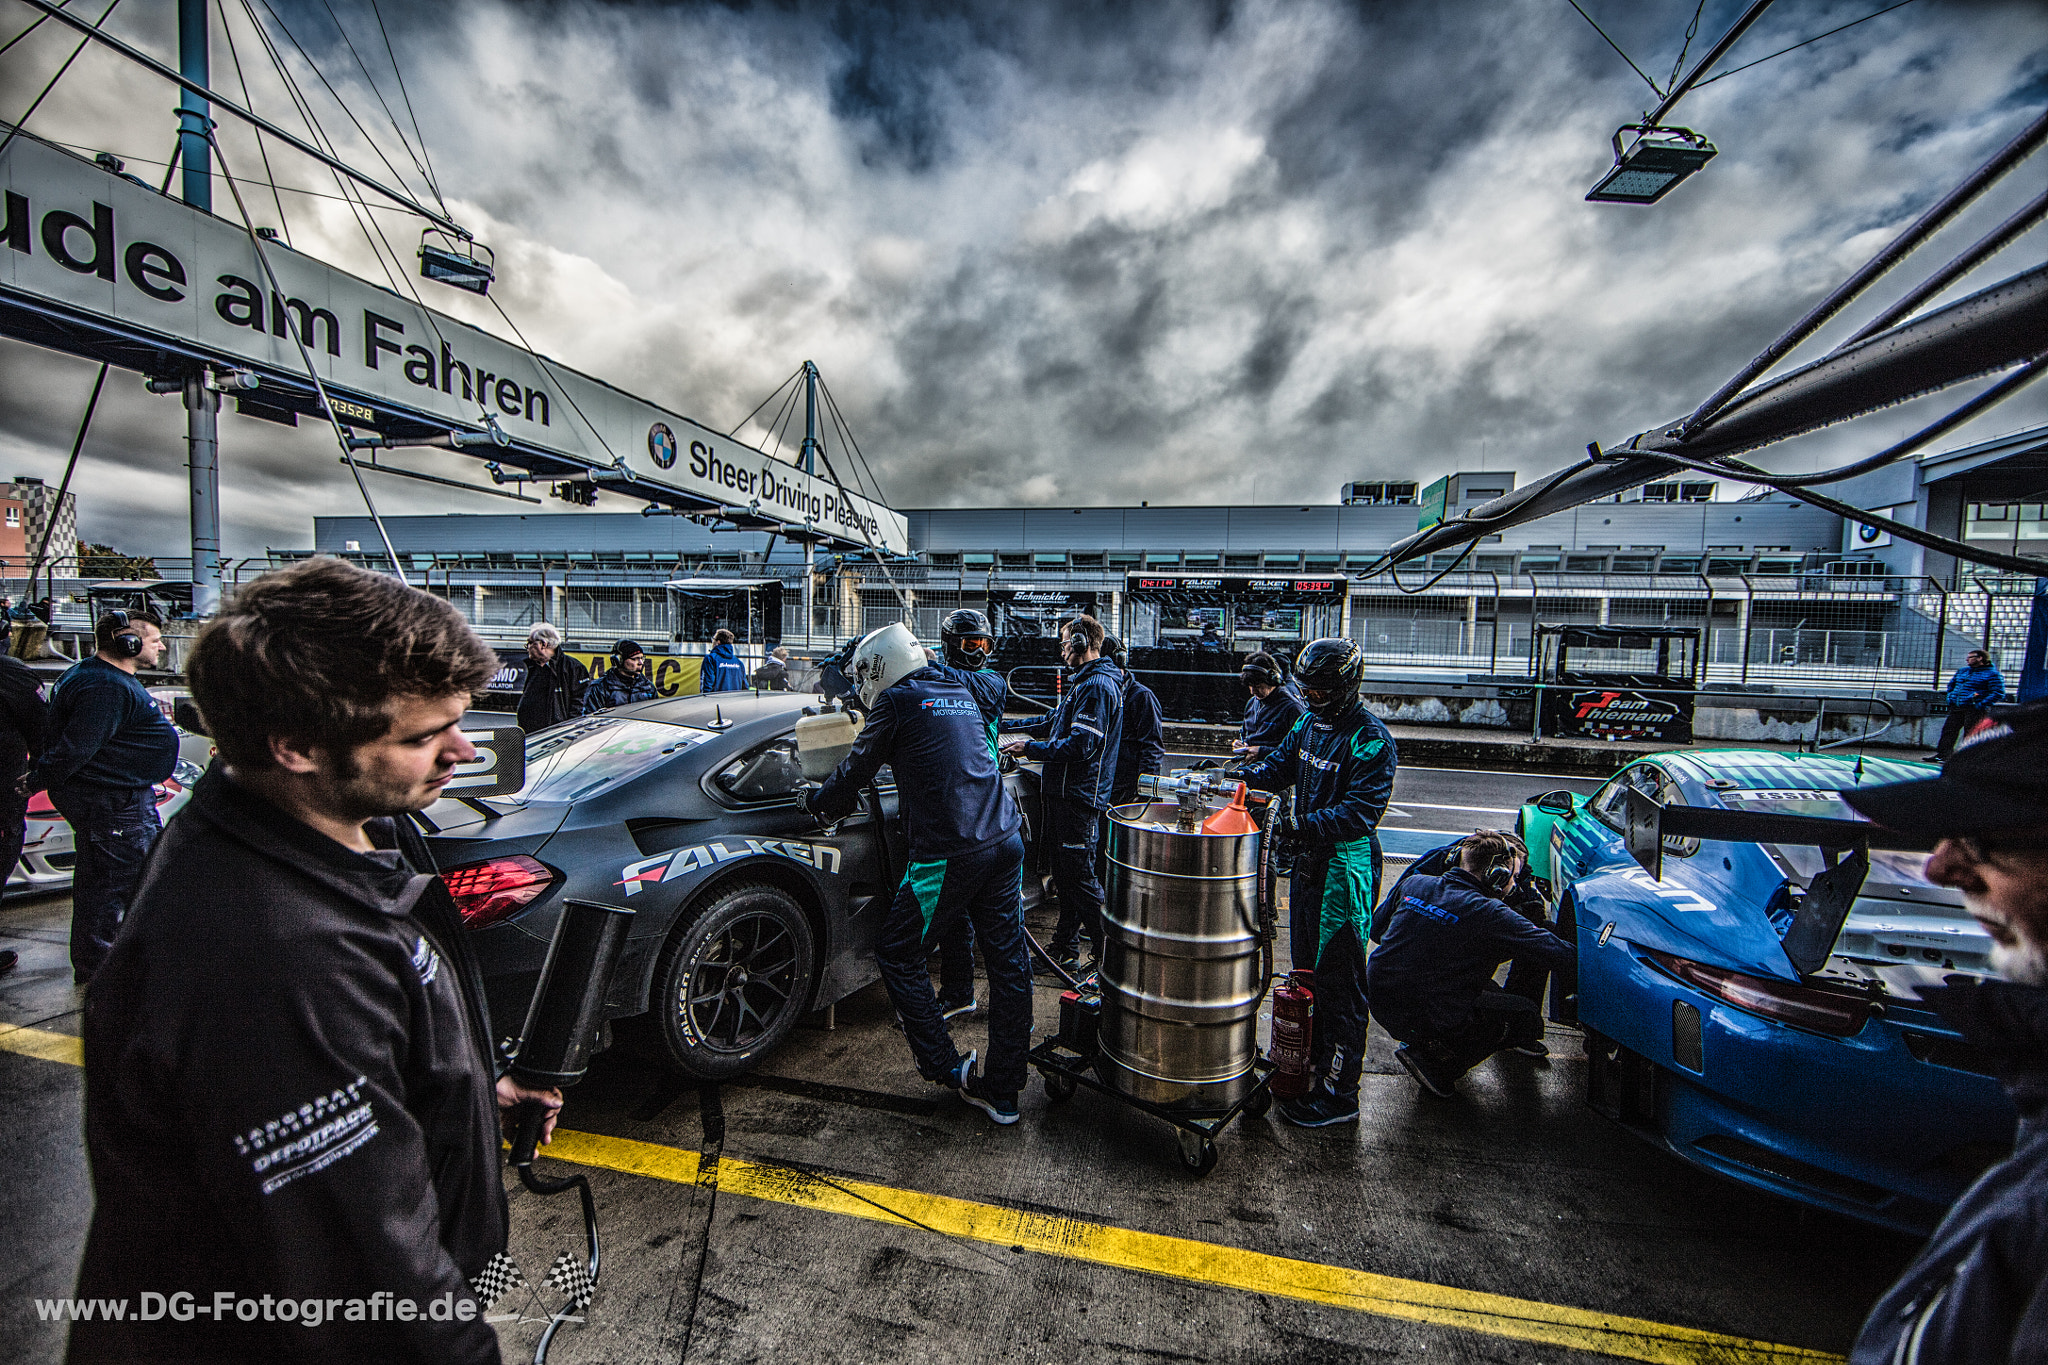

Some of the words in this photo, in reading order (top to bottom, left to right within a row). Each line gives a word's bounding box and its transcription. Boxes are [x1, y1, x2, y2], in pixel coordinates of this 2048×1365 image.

[216, 274, 340, 357] am
[364, 309, 550, 426] Fahren
[689, 440, 758, 495] Sheer
[762, 468, 820, 523] Driving
[825, 492, 878, 535] Pleasure
[1013, 591, 1070, 600] Schmickler
[1575, 702, 1674, 722] Thiemann
[1601, 692, 1649, 710] Team
[613, 839, 841, 897] FALKEN
[1404, 895, 1459, 925] FALKEN
